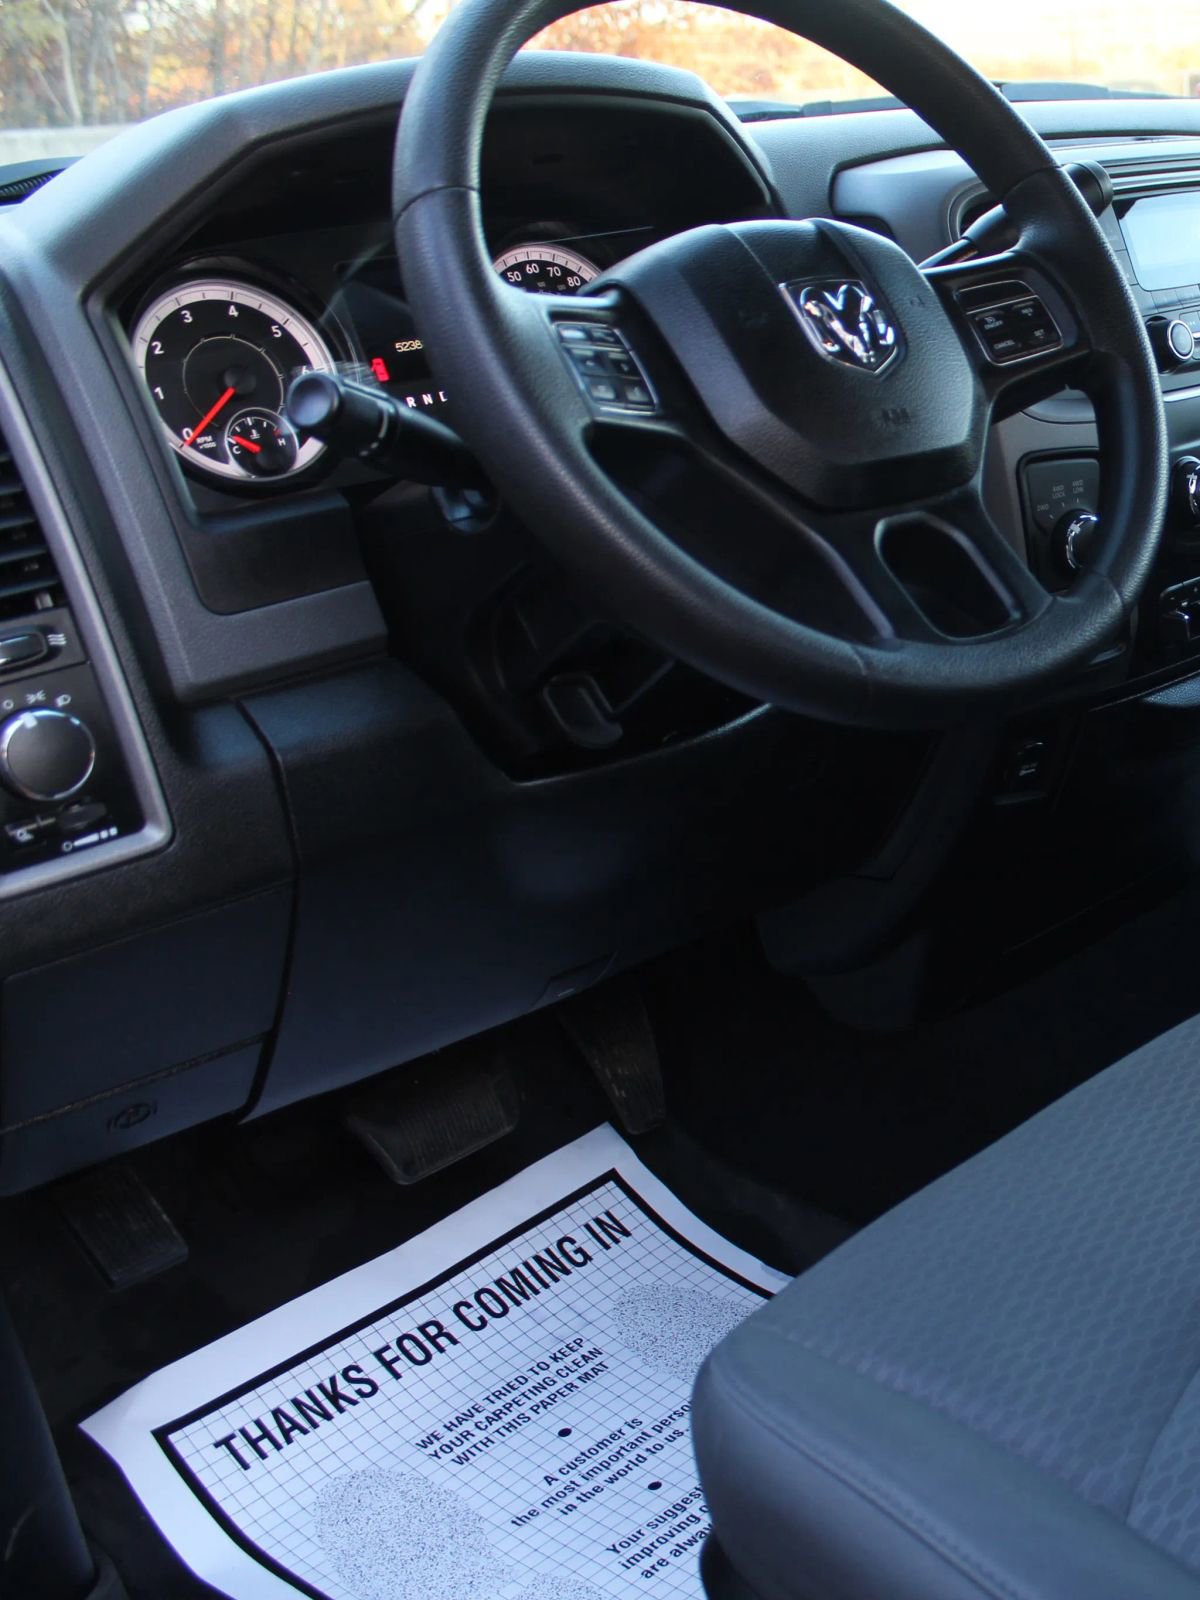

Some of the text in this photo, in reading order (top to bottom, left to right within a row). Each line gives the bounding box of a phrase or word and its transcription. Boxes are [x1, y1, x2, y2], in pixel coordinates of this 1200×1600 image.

[507, 263, 580, 287] 50 60 70 80
[181, 310, 193, 323] 3
[228, 305, 239, 317] 4
[271, 325, 282, 338] 5
[152, 341, 164, 354] 2
[154, 387, 164, 399] 1
[406, 397, 416, 408] R
[422, 394, 433, 405] N
[182, 428, 193, 441] 0
[278, 438, 286, 446] H
[233, 446, 241, 454] C
[213, 1210, 632, 1471] THANKS FOR COMING IN
[415, 1337, 585, 1449] WE HAVE TRIED TO KEEP
[429, 1347, 603, 1461] YOUR CARPETING CLEAN
[451, 1361, 610, 1466] WITH THIS PAPER MAT
[543, 1417, 643, 1486] A customer is
[511, 1402, 693, 1527] the most important perso
[557, 1428, 689, 1516] in the world to us.
[606, 1528, 645, 1554] Your
[618, 1513, 701, 1570] improving
[641, 1558, 670, 1579] are
